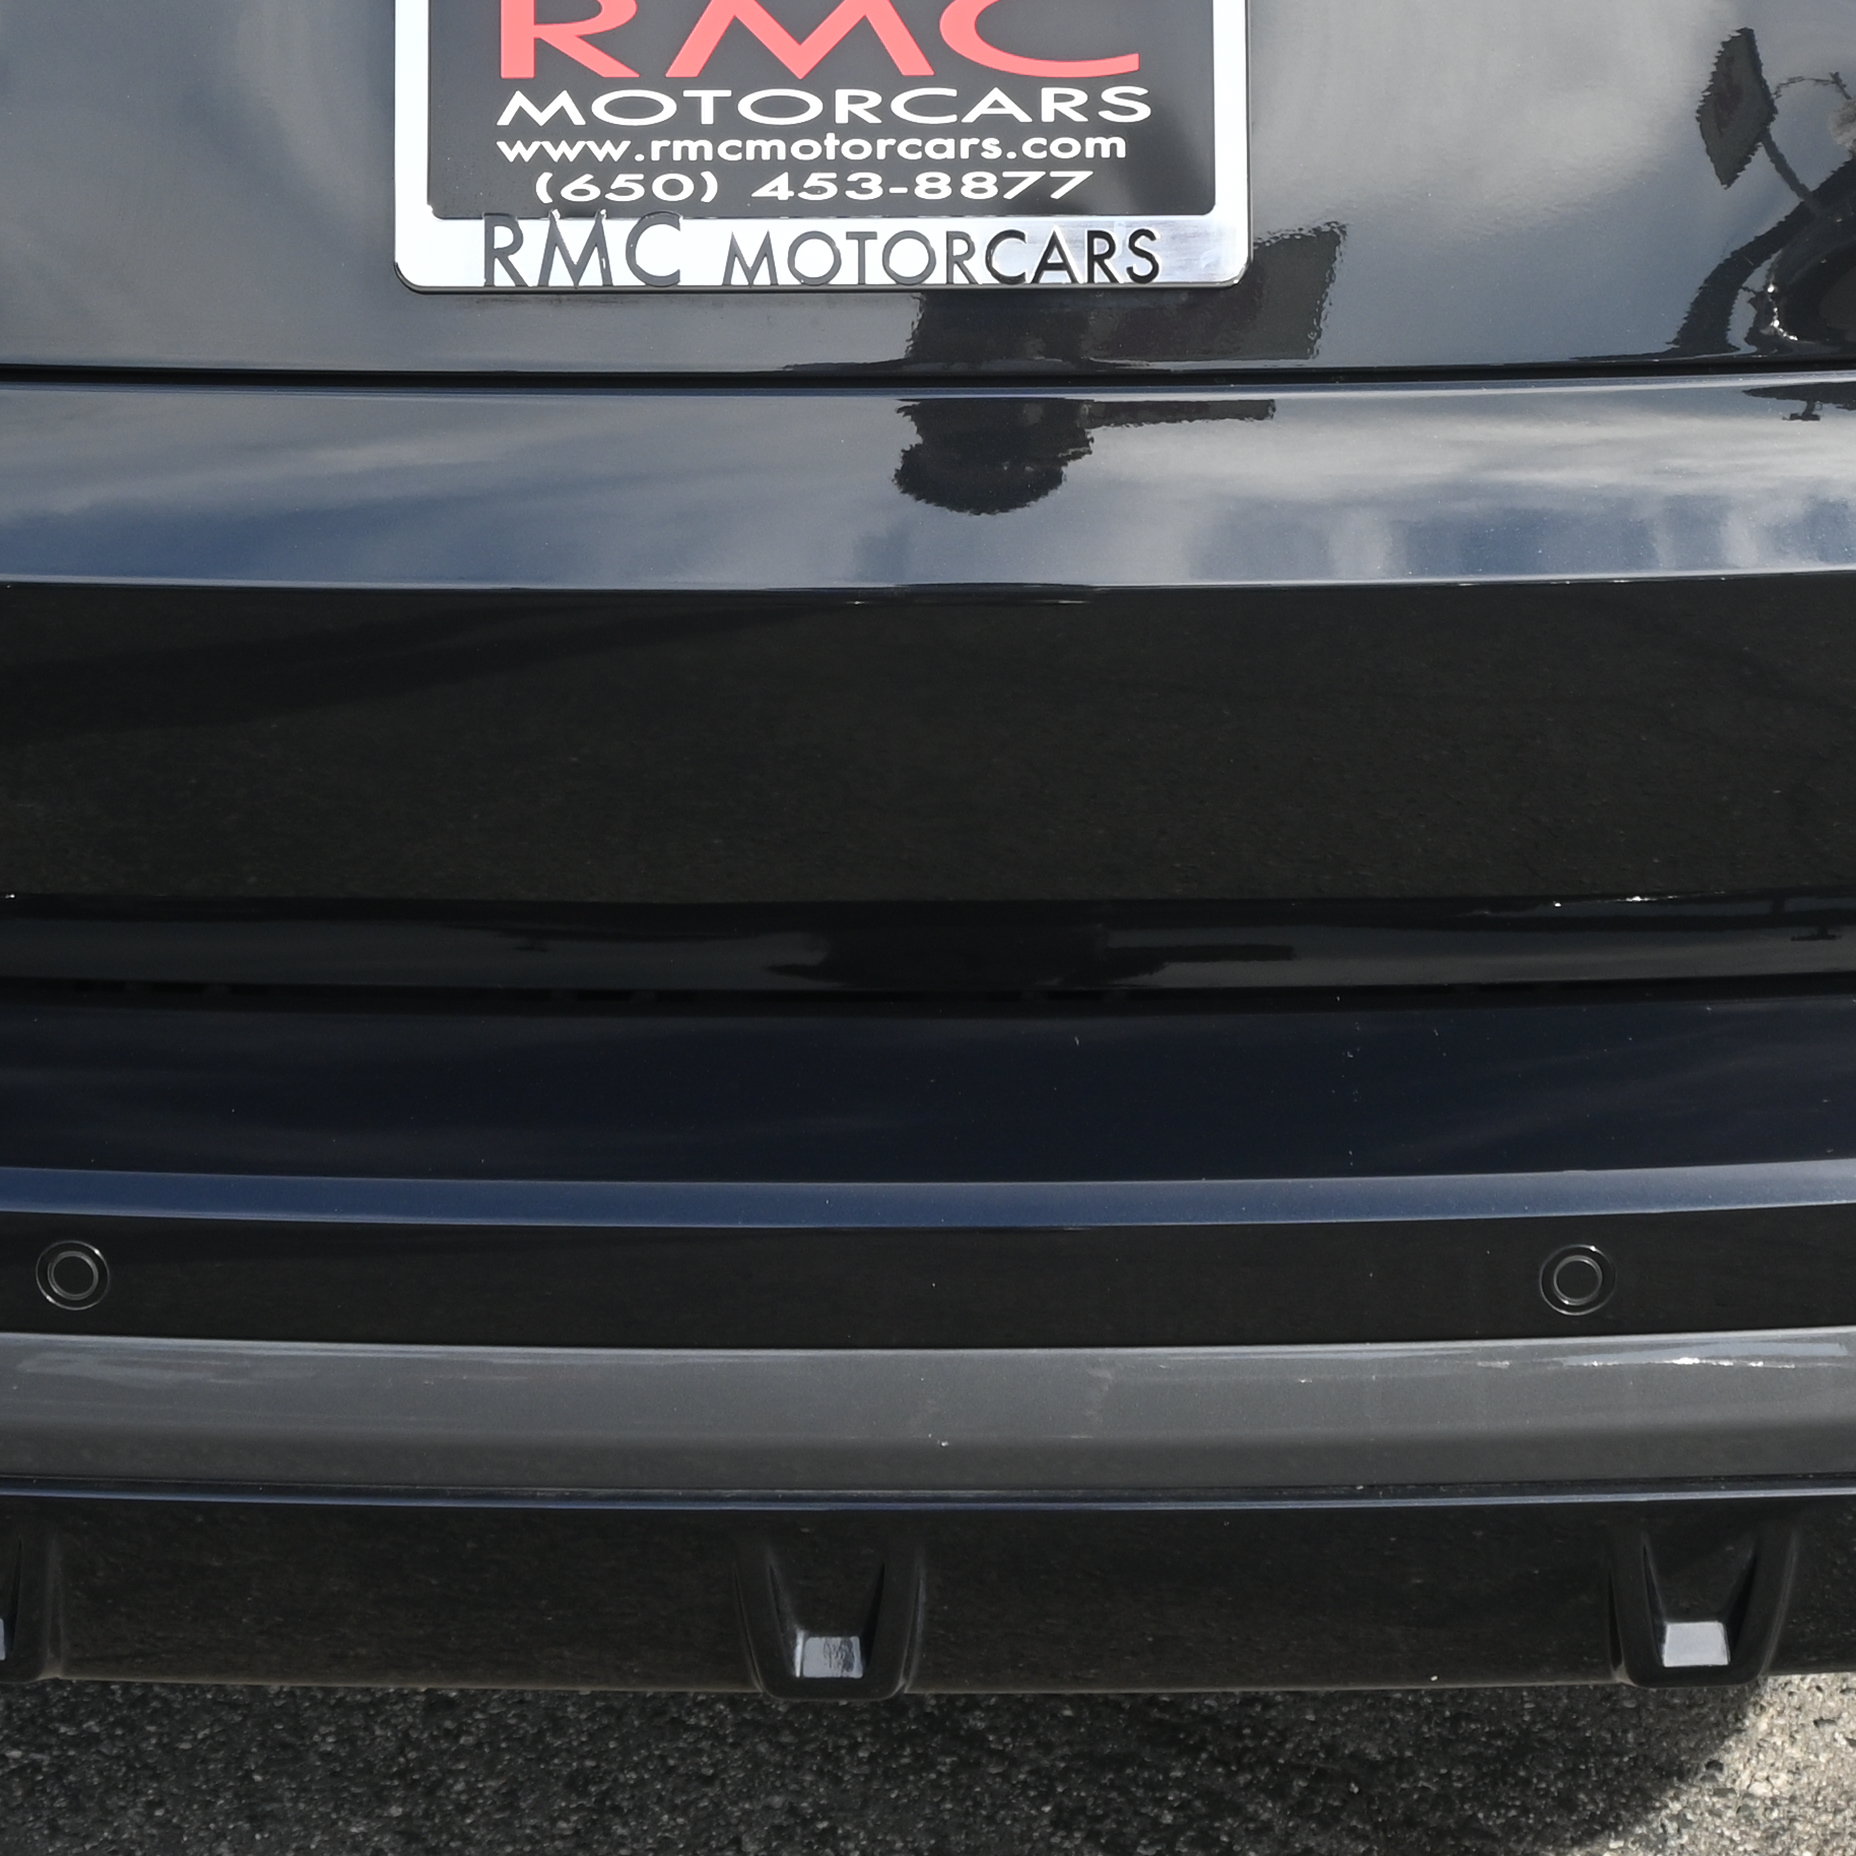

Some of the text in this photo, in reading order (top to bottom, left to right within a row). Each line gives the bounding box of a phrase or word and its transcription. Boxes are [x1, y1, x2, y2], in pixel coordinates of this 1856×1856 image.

[496, 86, 1151, 127] MOTORCARS
[496, 133, 1127, 164] www.rmcmotorcars.com
[535, 170, 1094, 203] (650) 453-8877
[483, 211, 1162, 288] RMC MOTORCARS
